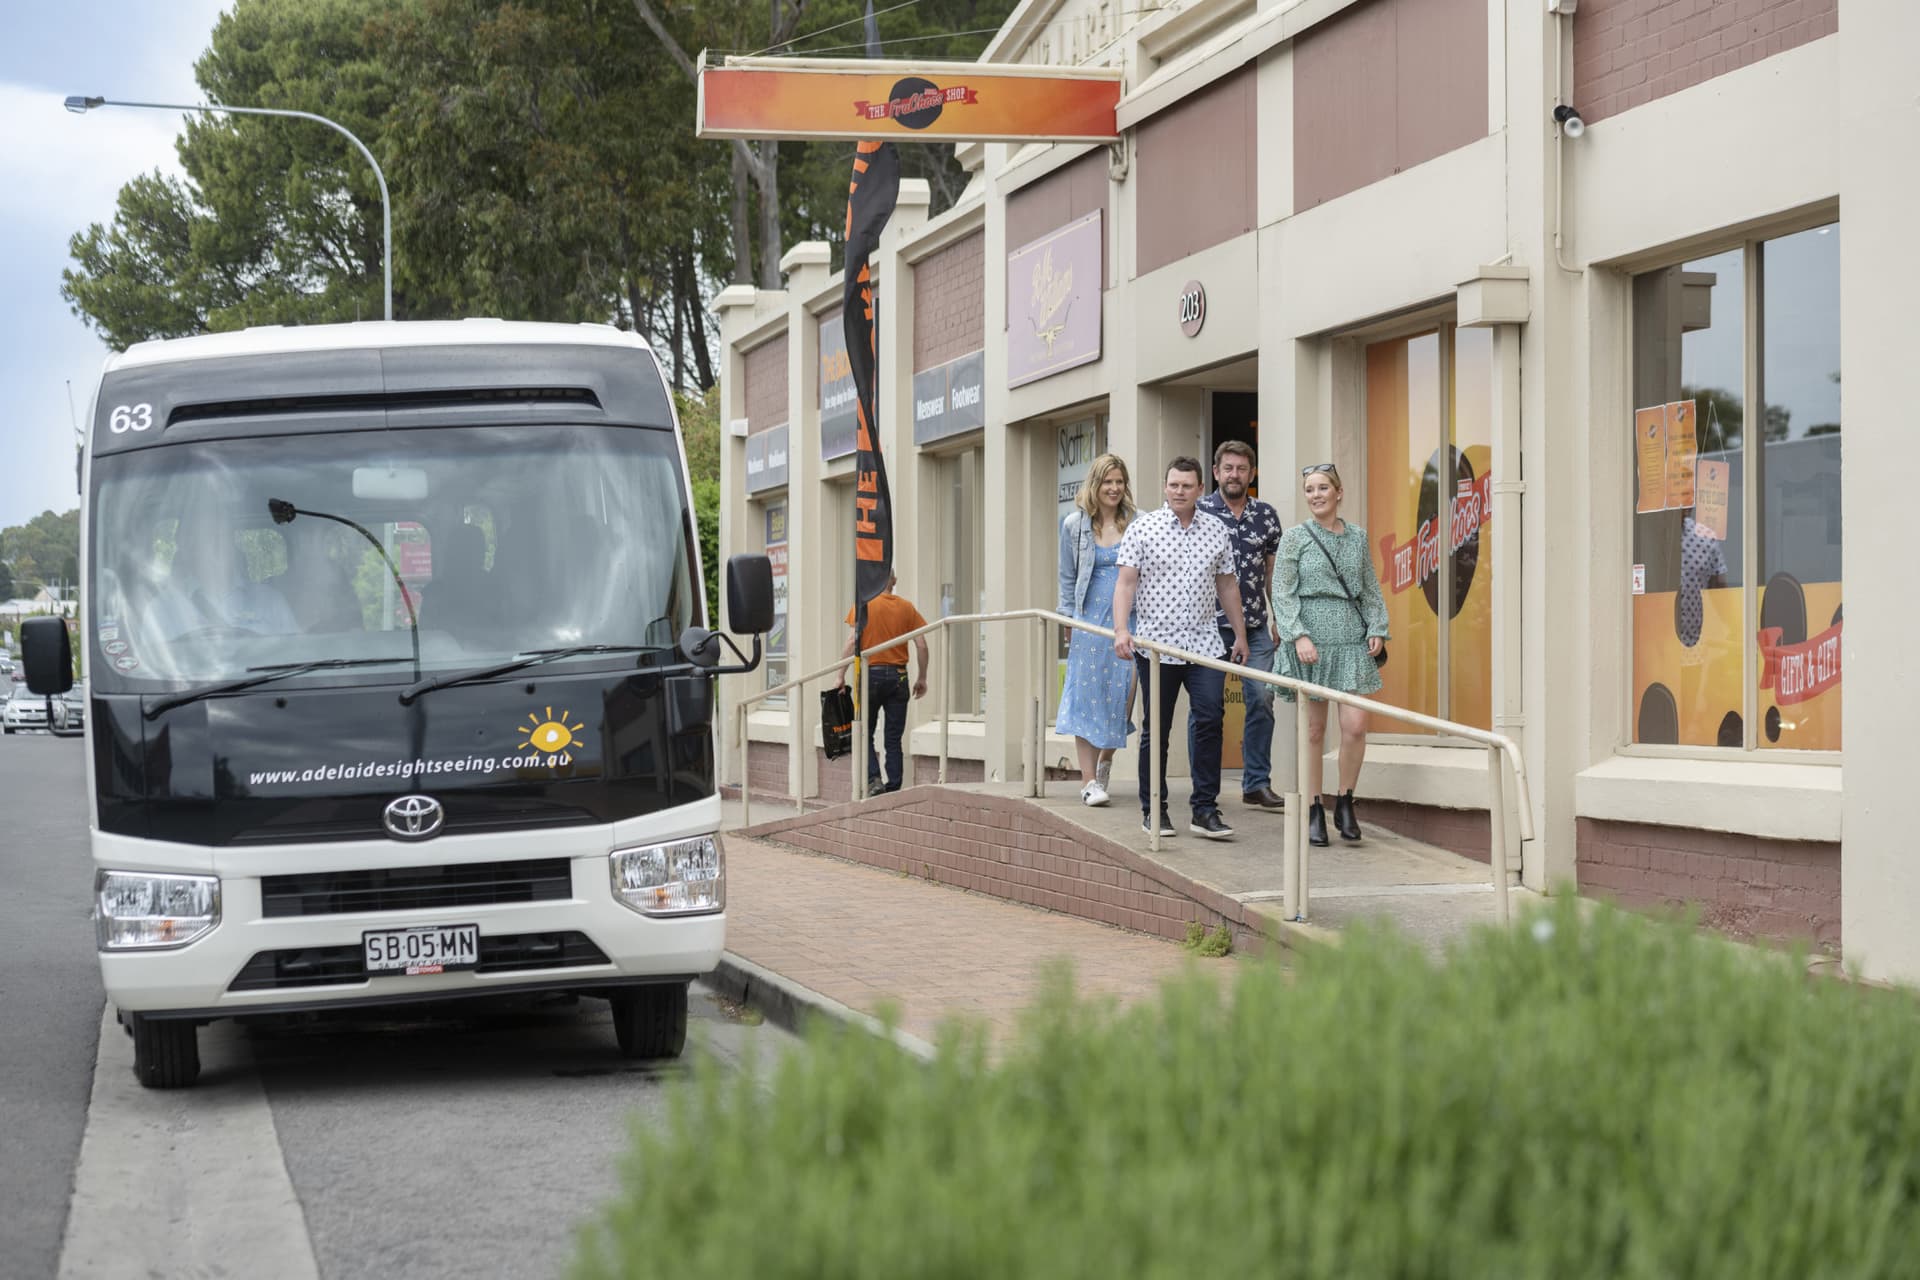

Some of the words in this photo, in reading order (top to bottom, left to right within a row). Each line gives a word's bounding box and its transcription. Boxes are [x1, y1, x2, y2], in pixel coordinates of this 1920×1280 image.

[868, 105, 885, 119] THE
[946, 87, 965, 101] SHOP
[1181, 290, 1200, 323] 203
[952, 384, 980, 410] Footwear
[109, 403, 153, 434] 63
[1394, 546, 1412, 588] THE
[1781, 653, 1805, 696] GIFTS
[1807, 649, 1815, 689] &
[1817, 635, 1837, 684] GIFT
[1224, 687, 1243, 704] Sou
[250, 752, 571, 785] www.adelaidesightseeing.com.au
